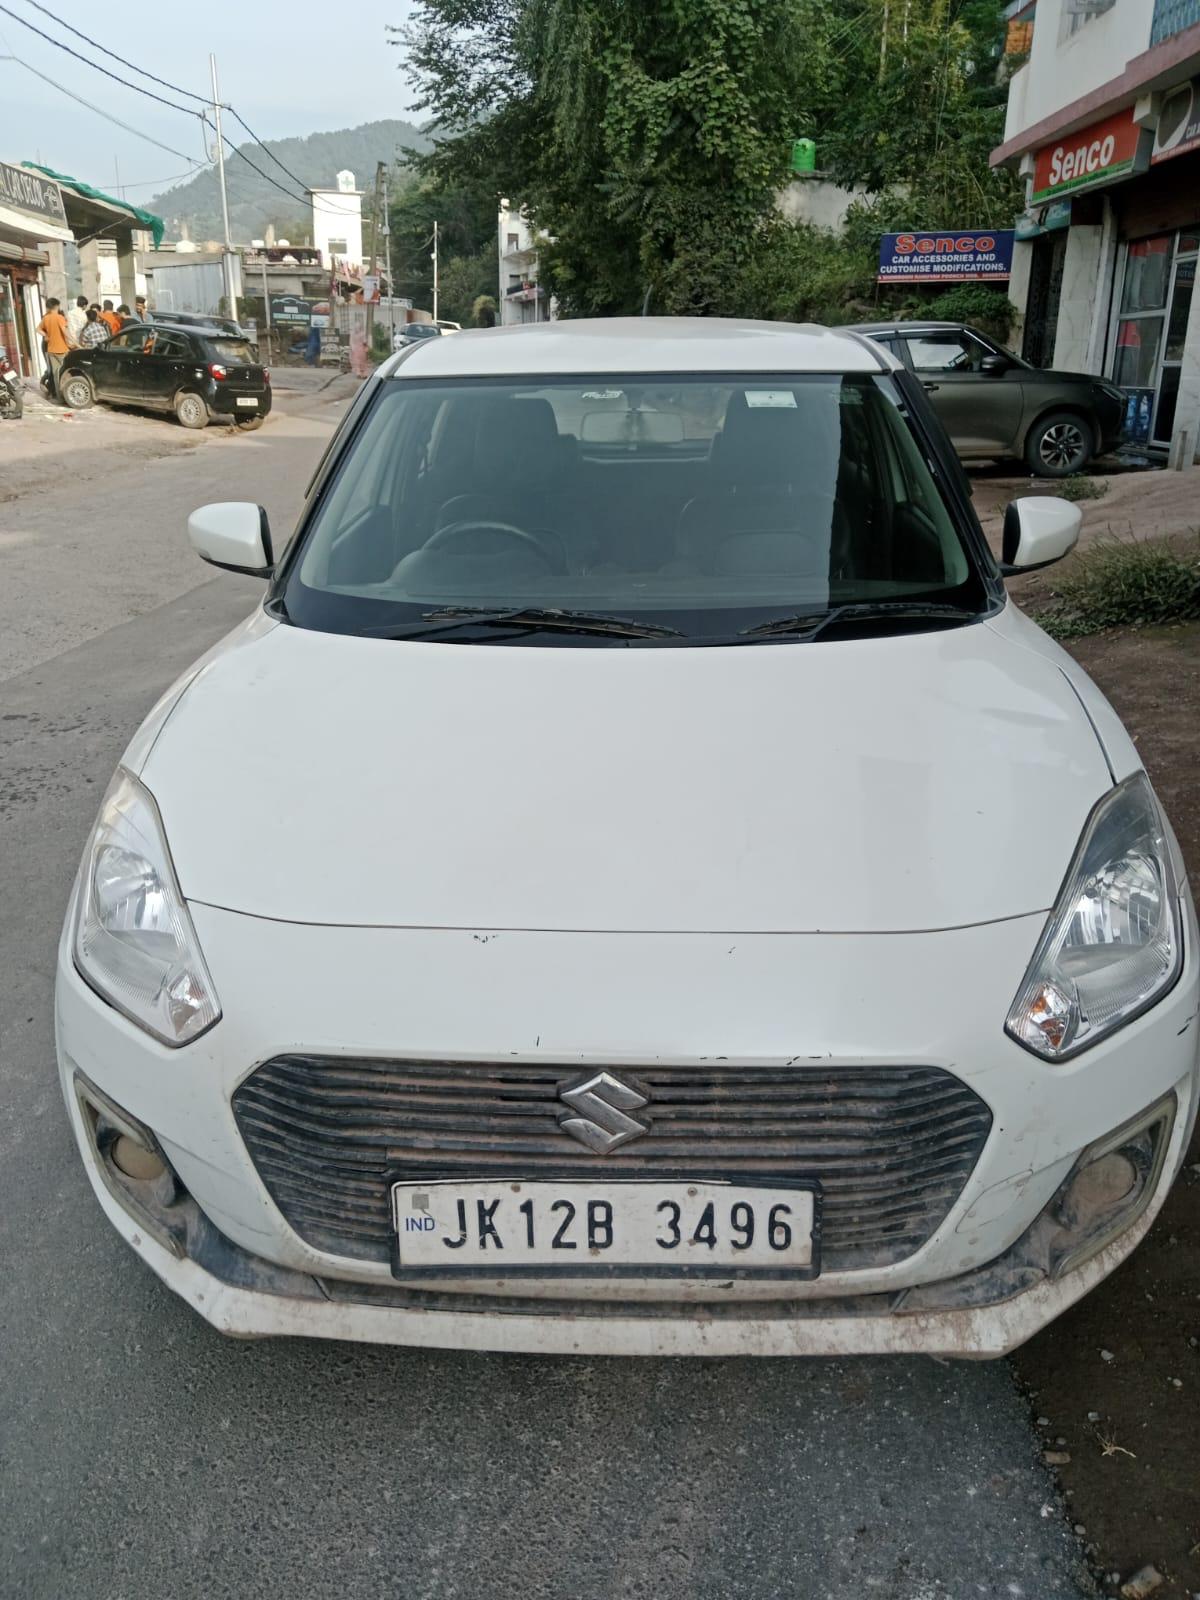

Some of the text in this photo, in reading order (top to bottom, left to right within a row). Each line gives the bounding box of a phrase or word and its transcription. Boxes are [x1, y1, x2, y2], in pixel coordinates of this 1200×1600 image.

[1049, 135, 1115, 185] Senco
[895, 234, 995, 254] Senco
[892, 253, 996, 264] CAR ACCESSORIES AND
[880, 263, 1007, 274] CUSTOMISE MODIFICATIONS.
[406, 1217, 435, 1232] IND
[442, 1198, 793, 1251] JK12B 3496
